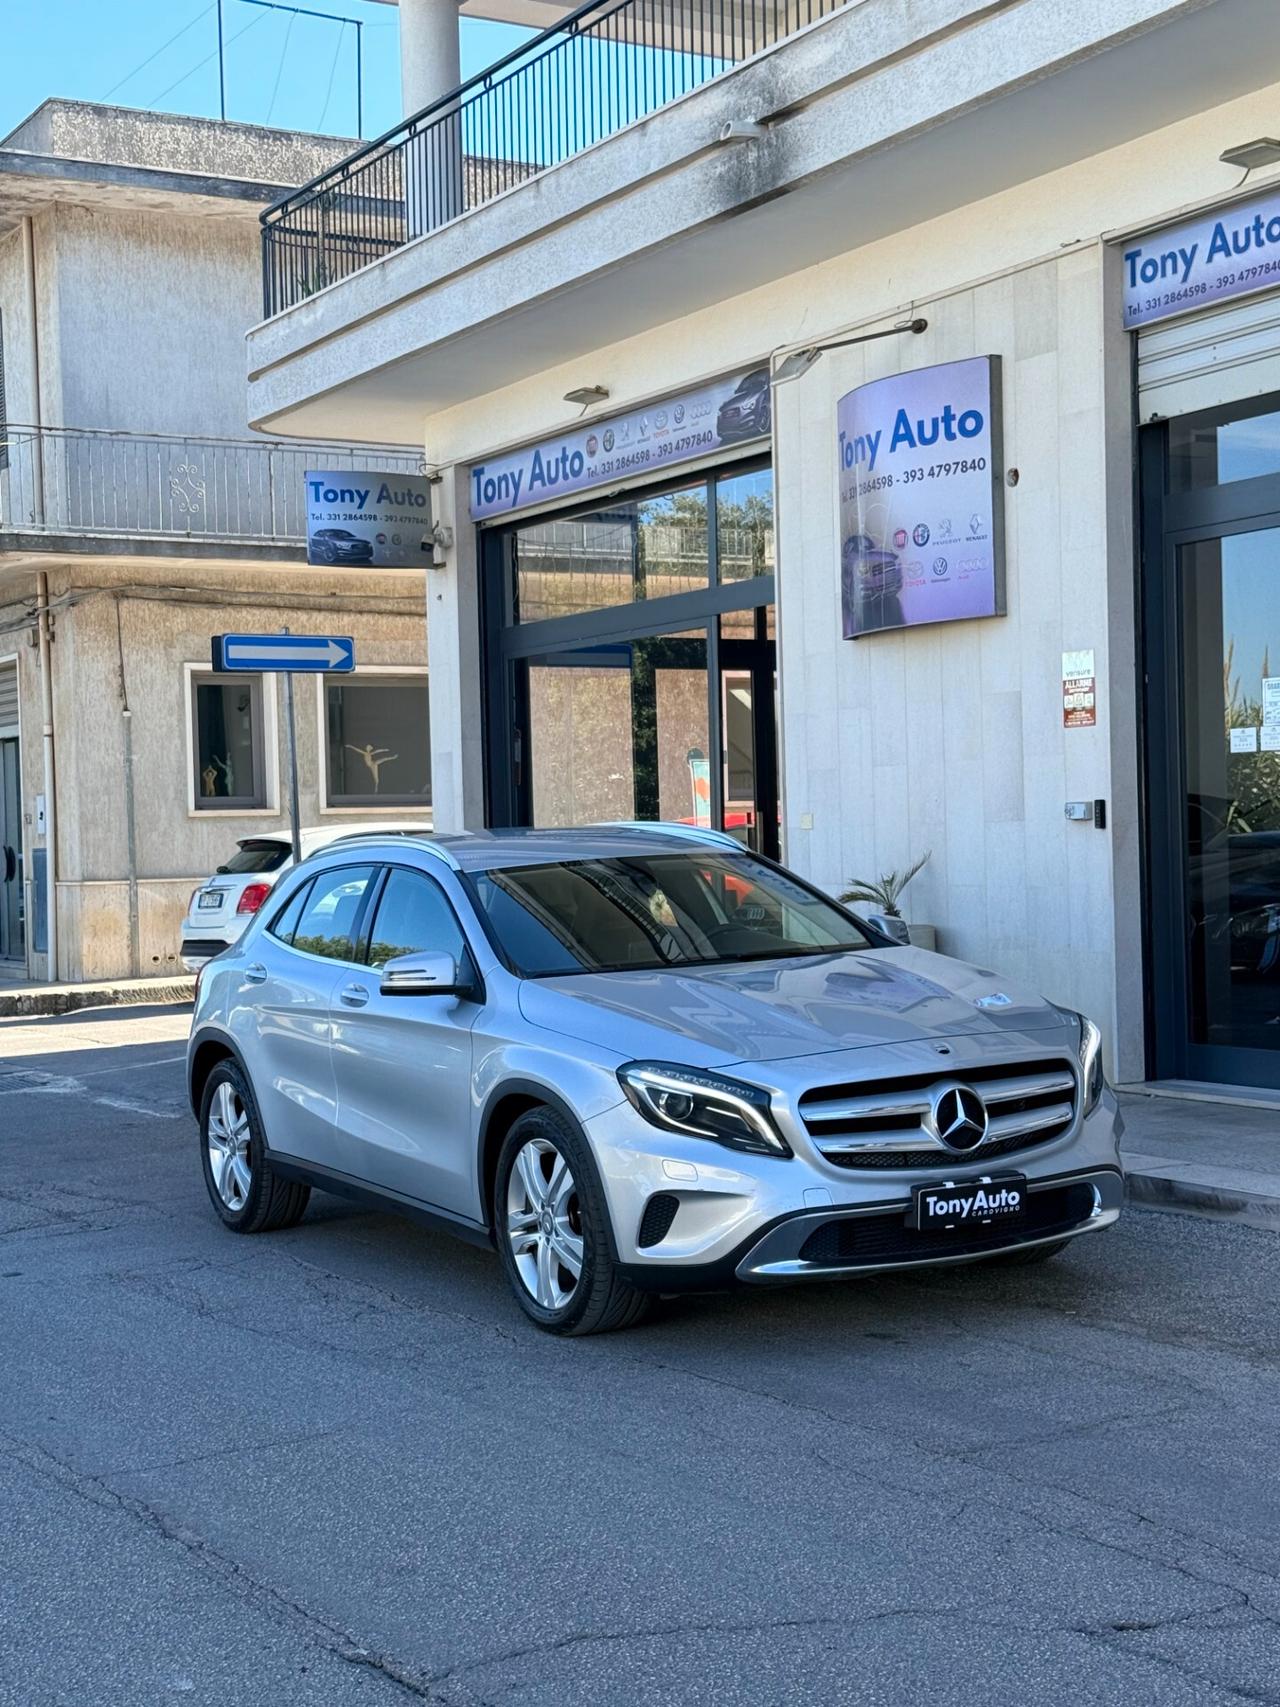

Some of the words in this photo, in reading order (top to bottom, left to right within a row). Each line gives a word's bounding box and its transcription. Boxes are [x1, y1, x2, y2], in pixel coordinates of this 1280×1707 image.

[1125, 243, 1198, 288] Tony
[1206, 214, 1280, 265] Auto
[1127, 303, 1143, 316] Tel.
[1145, 296, 1161, 311] 331
[1163, 282, 1207, 305] 2864598
[1216, 273, 1235, 289] 393
[587, 467, 598, 478] Tel.
[601, 460, 614, 475] 331
[615, 449, 650, 470] 2864598
[657, 441, 673, 458] 393
[674, 430, 713, 451] 4797840
[839, 430, 882, 472] Tony
[889, 404, 984, 453] Auto
[472, 467, 523, 508] Tony
[529, 446, 584, 492] Auto
[903, 468, 924, 484] 393
[927, 457, 986, 479] 4797840
[309, 481, 370, 509] Tony
[376, 483, 426, 507] Auto
[311, 513, 324, 521] Tel.
[327, 513, 341, 521] 331
[343, 513, 378, 522] 2864598
[926, 1189, 1020, 1218] TonyAuto
[971, 1205, 1020, 1217] CAROVIGNO
